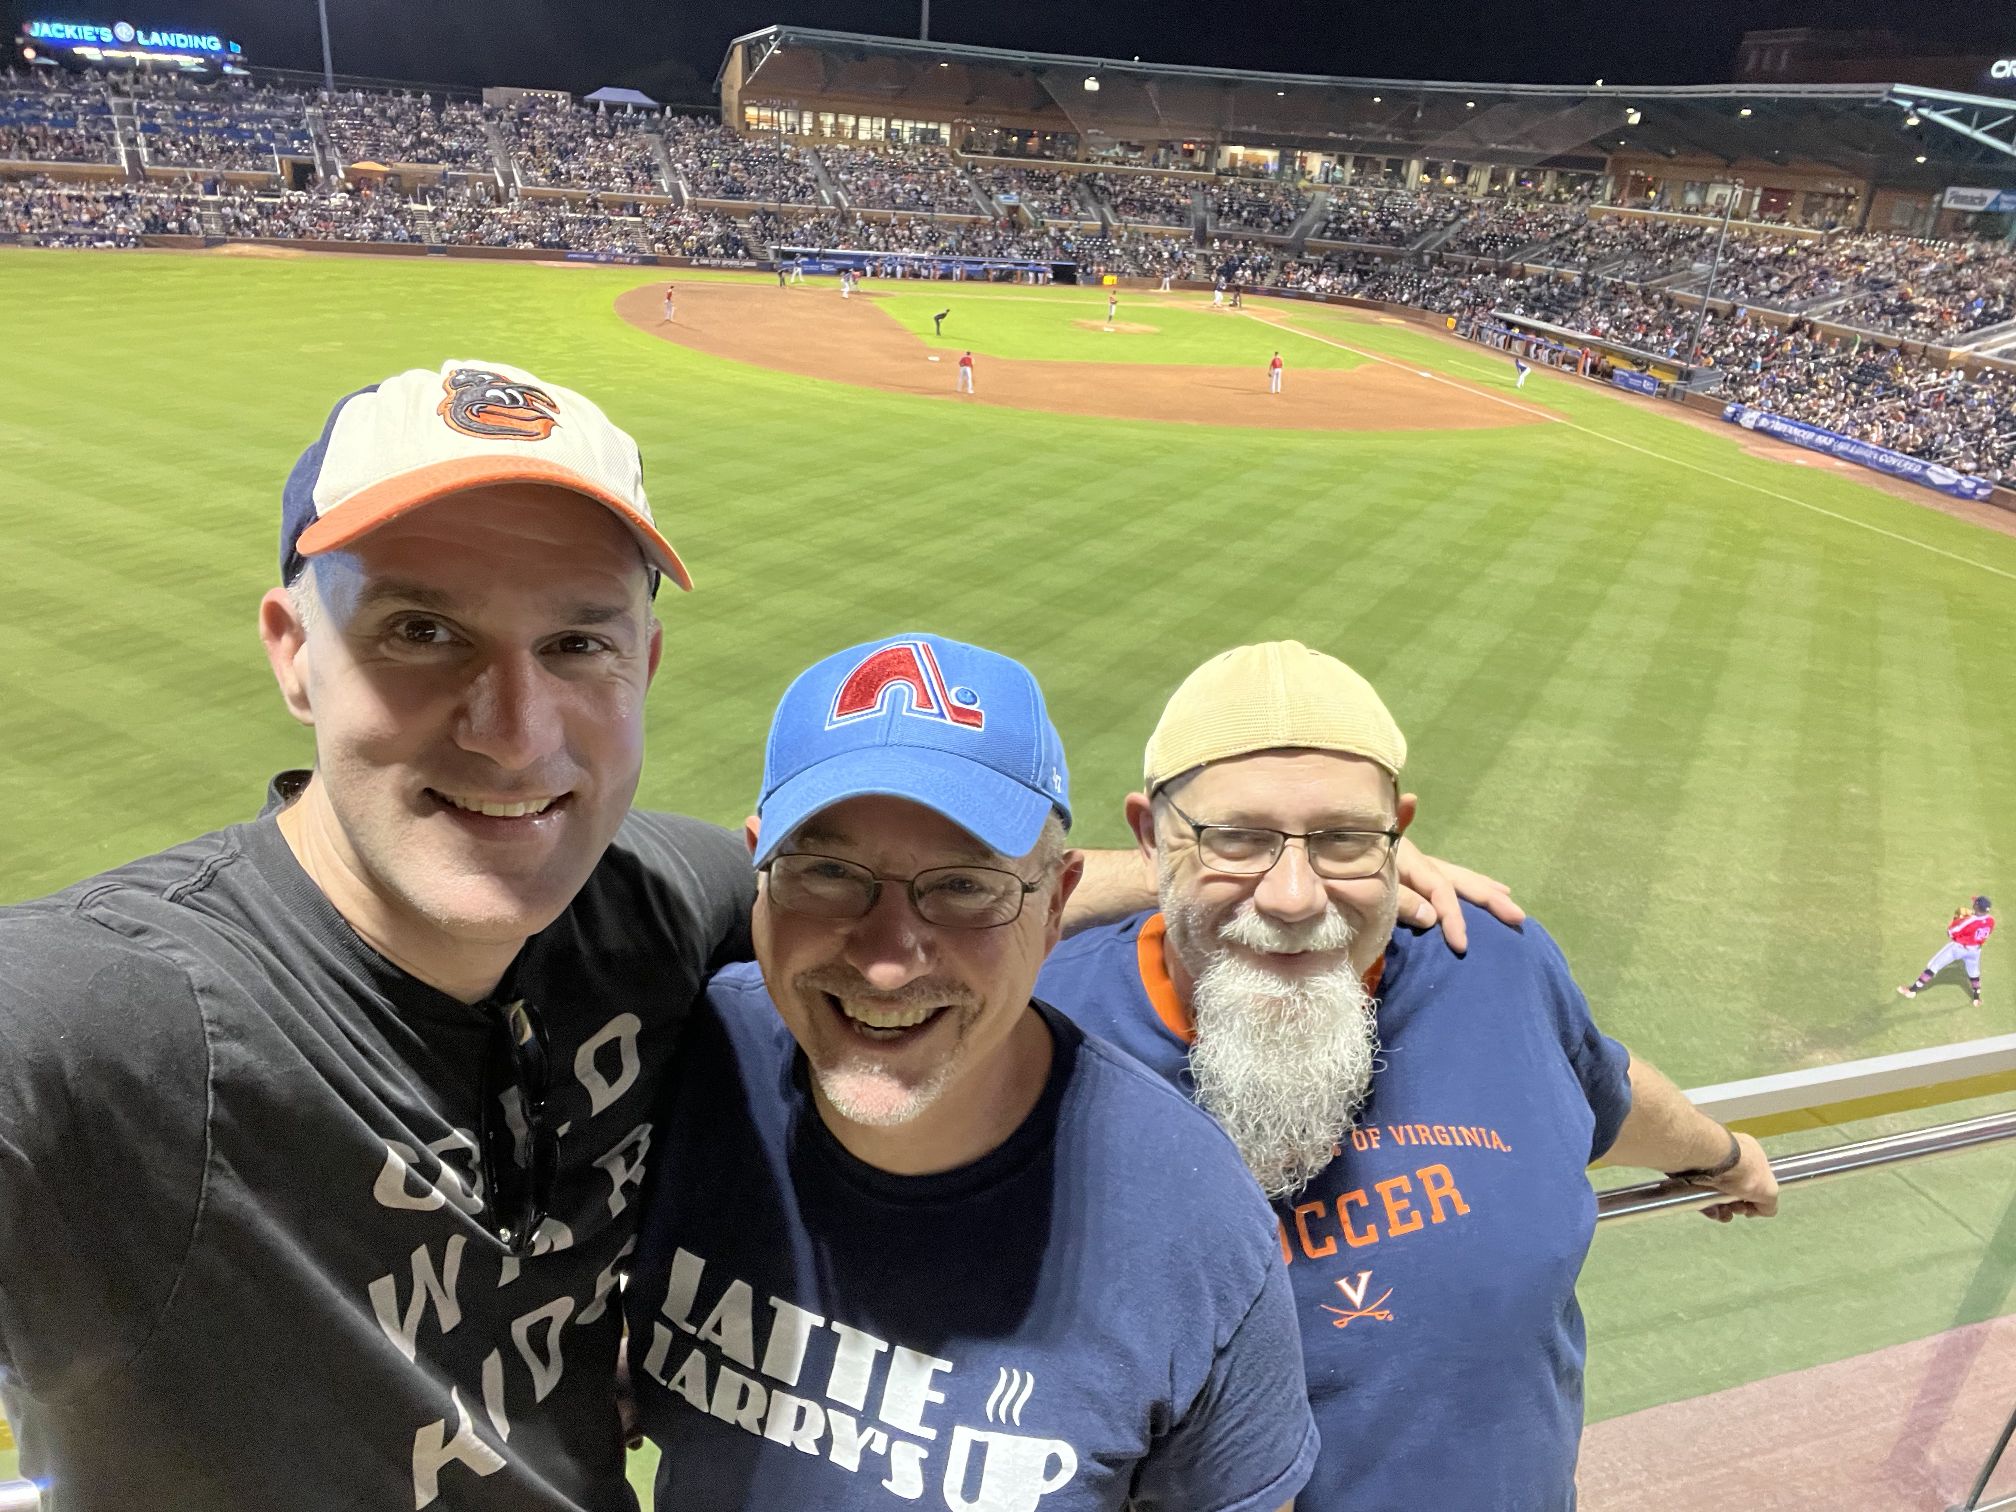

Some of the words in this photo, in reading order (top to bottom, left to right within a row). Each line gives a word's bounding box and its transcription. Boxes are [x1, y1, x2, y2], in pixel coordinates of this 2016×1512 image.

[30, 21, 113, 43] JACKIE'S
[136, 30, 222, 51] LANDING
[1352, 1128, 1381, 1151] OF
[1277, 1163, 1471, 1265] CCER
[660, 1246, 954, 1441] LATTE
[643, 1320, 930, 1501] LARRY'S
